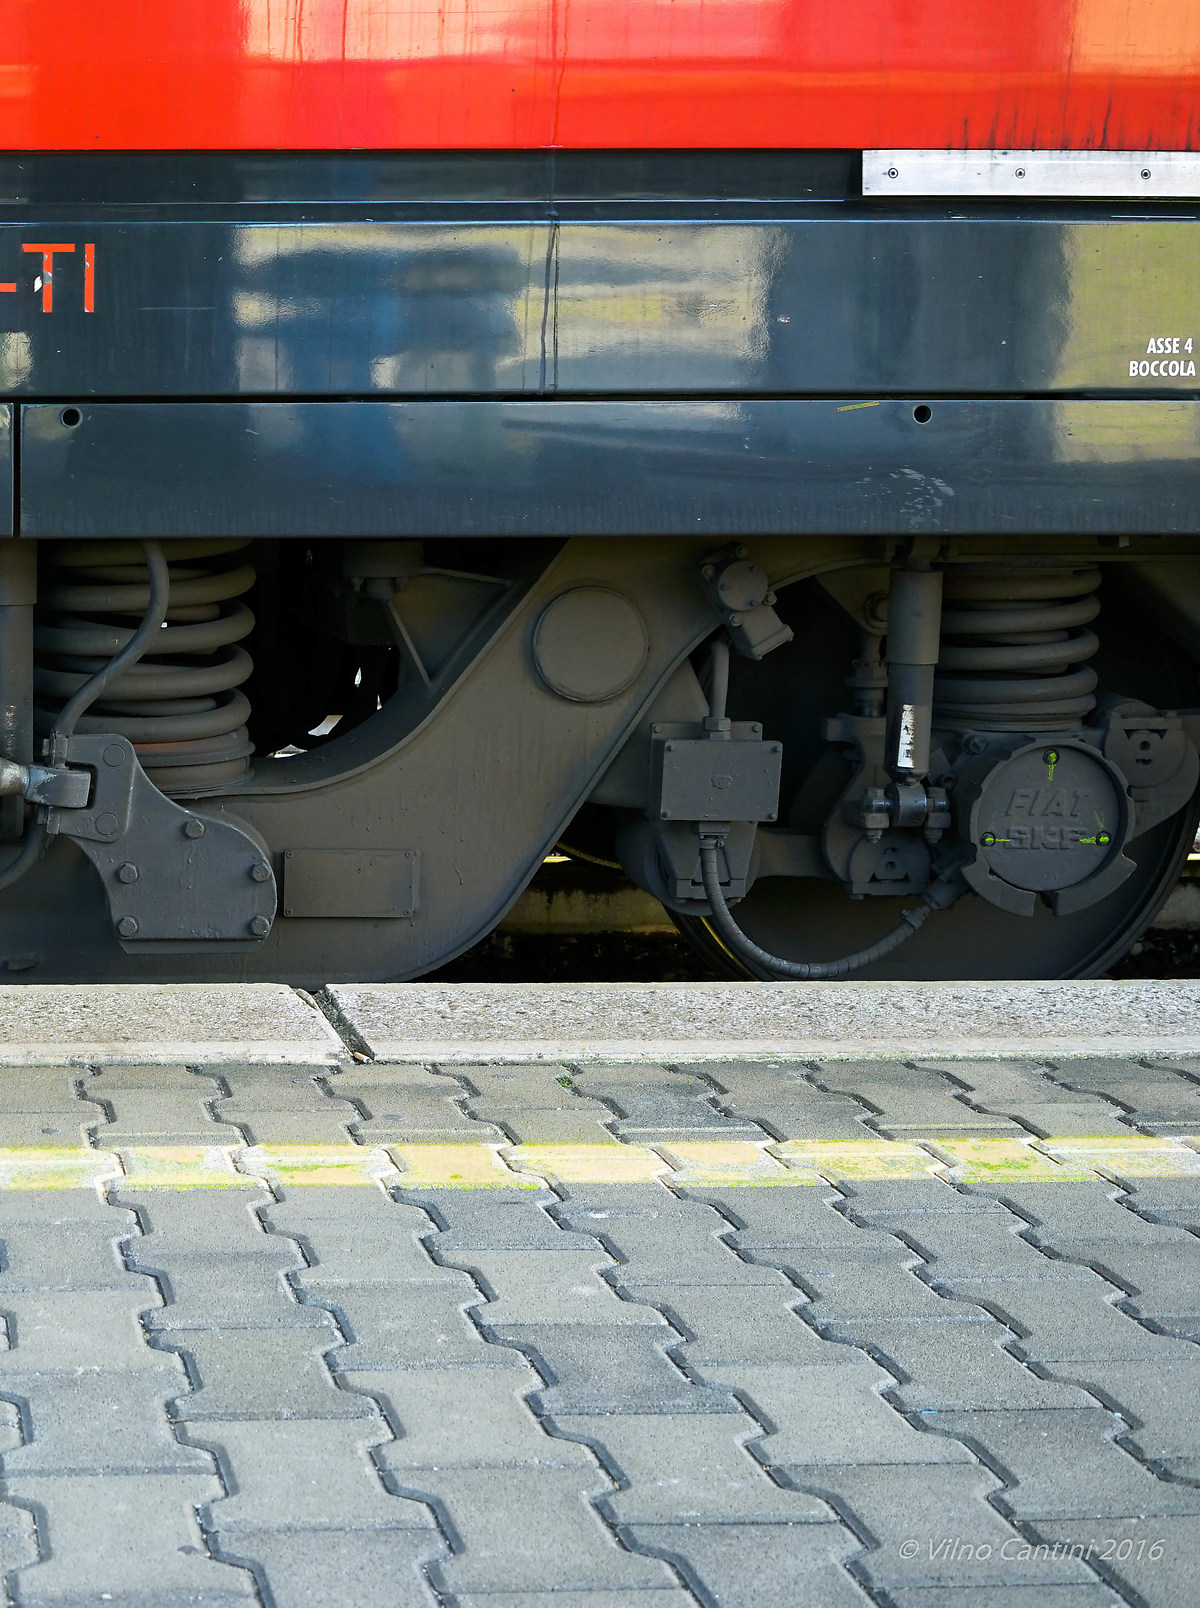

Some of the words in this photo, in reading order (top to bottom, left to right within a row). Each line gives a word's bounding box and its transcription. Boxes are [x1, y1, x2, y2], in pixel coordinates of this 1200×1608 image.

[1146, 337, 1181, 354] ASSE
[1184, 337, 1193, 354] 4
[1128, 360, 1197, 377] BOCCOLA
[1005, 788, 1090, 817] FIAT
